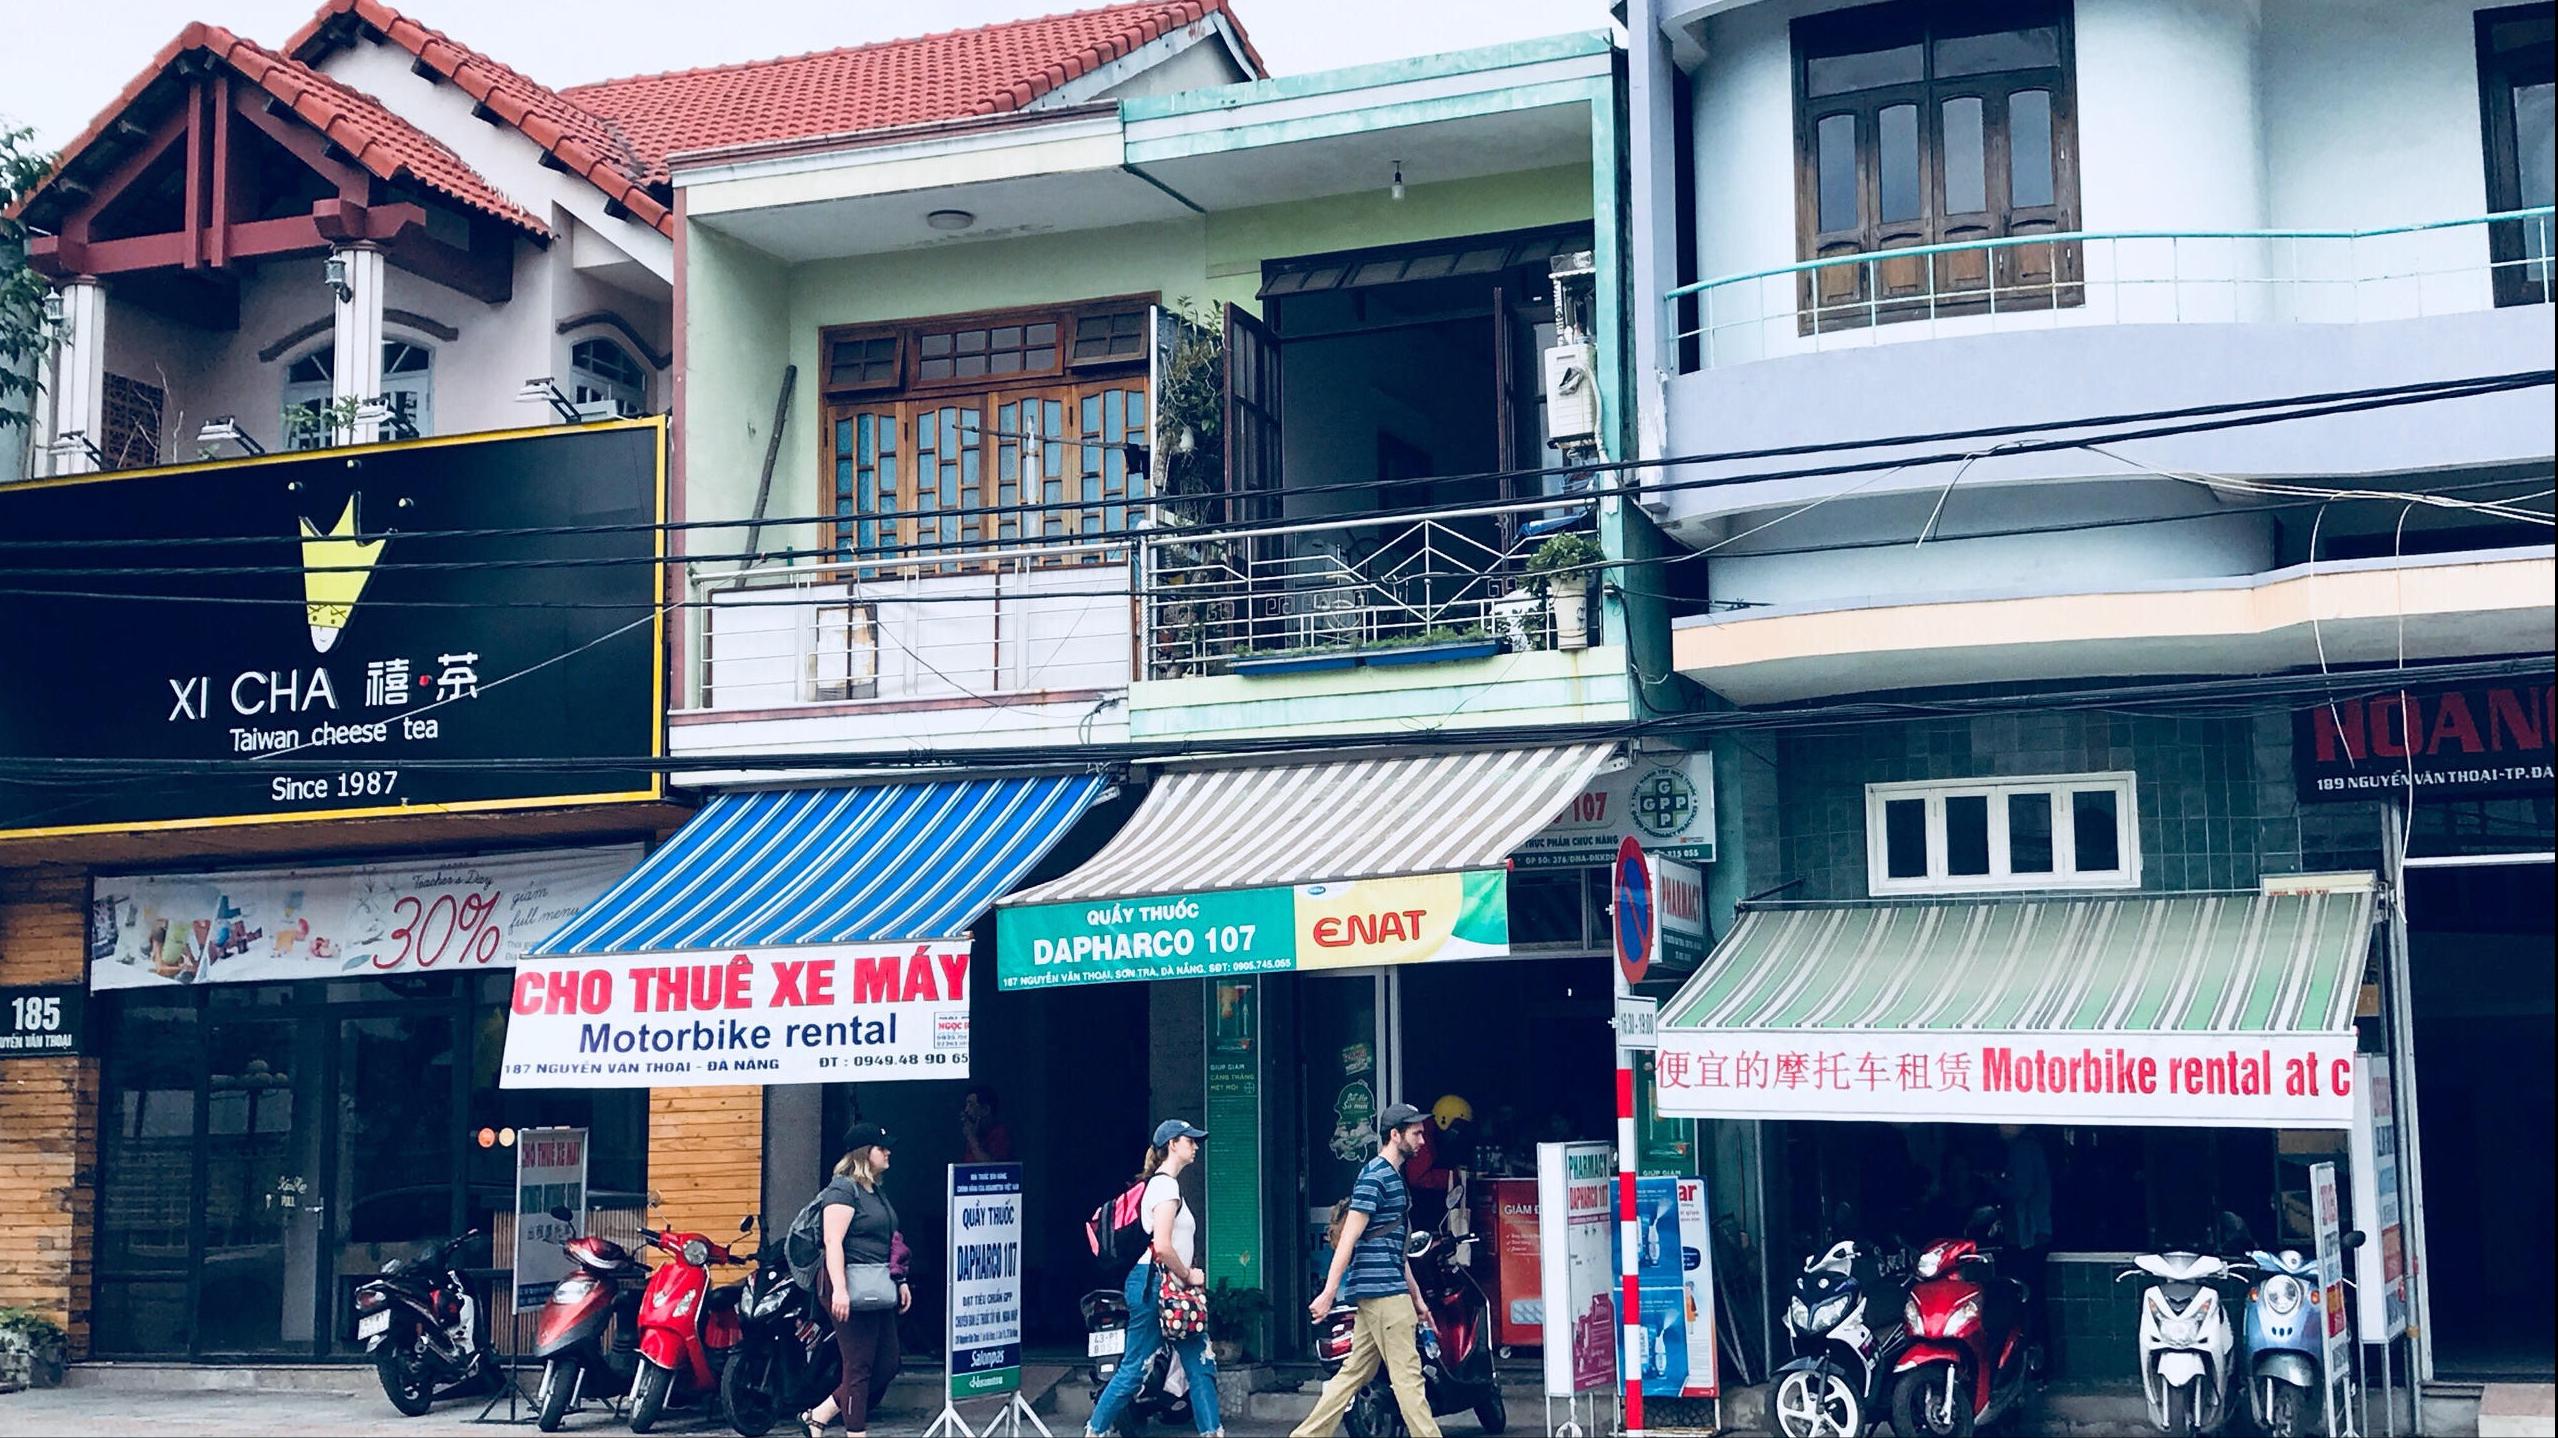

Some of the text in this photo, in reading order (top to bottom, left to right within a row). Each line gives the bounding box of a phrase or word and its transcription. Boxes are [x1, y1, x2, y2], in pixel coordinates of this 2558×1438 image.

[169, 675, 209, 721] XI
[231, 666, 337, 715] CHA
[229, 717, 439, 752] Taiwan cheese tea
[2313, 685, 2555, 762] HOAN
[272, 770, 398, 801] Since 1987
[2317, 778, 2344, 790] 189
[2414, 770, 2445, 785] VĂN
[1573, 792, 1607, 822] 107
[412, 869, 495, 890] Teacher's Day
[508, 906, 580, 935] full menu
[1139, 897, 1200, 922] THUỐC
[373, 891, 501, 970] 30%
[1033, 925, 1256, 965] DAPHARCO 107
[1313, 910, 1427, 947] ENAT
[511, 945, 969, 1015] CHO THUÊ XE MÁY
[12, 997, 60, 1030] 185
[579, 1012, 897, 1053] Motorbike rental
[505, 1064, 531, 1074] 187
[854, 1053, 918, 1066] 0949.48
[925, 1053, 946, 1064] 90
[952, 1052, 968, 1064] 65
[1655, 1049, 1971, 1092] 便宜的摩托车租赁
[1982, 1047, 2157, 1094] Motorbike
[2169, 1050, 2271, 1096] rental
[2286, 1051, 2319, 1096] at
[1568, 1154, 1608, 1180] PHARMACY
[1678, 1185, 1697, 1201] ar
[988, 1199, 1014, 1225] THUỐC
[957, 1241, 1017, 1281] DAPHARCO 107
